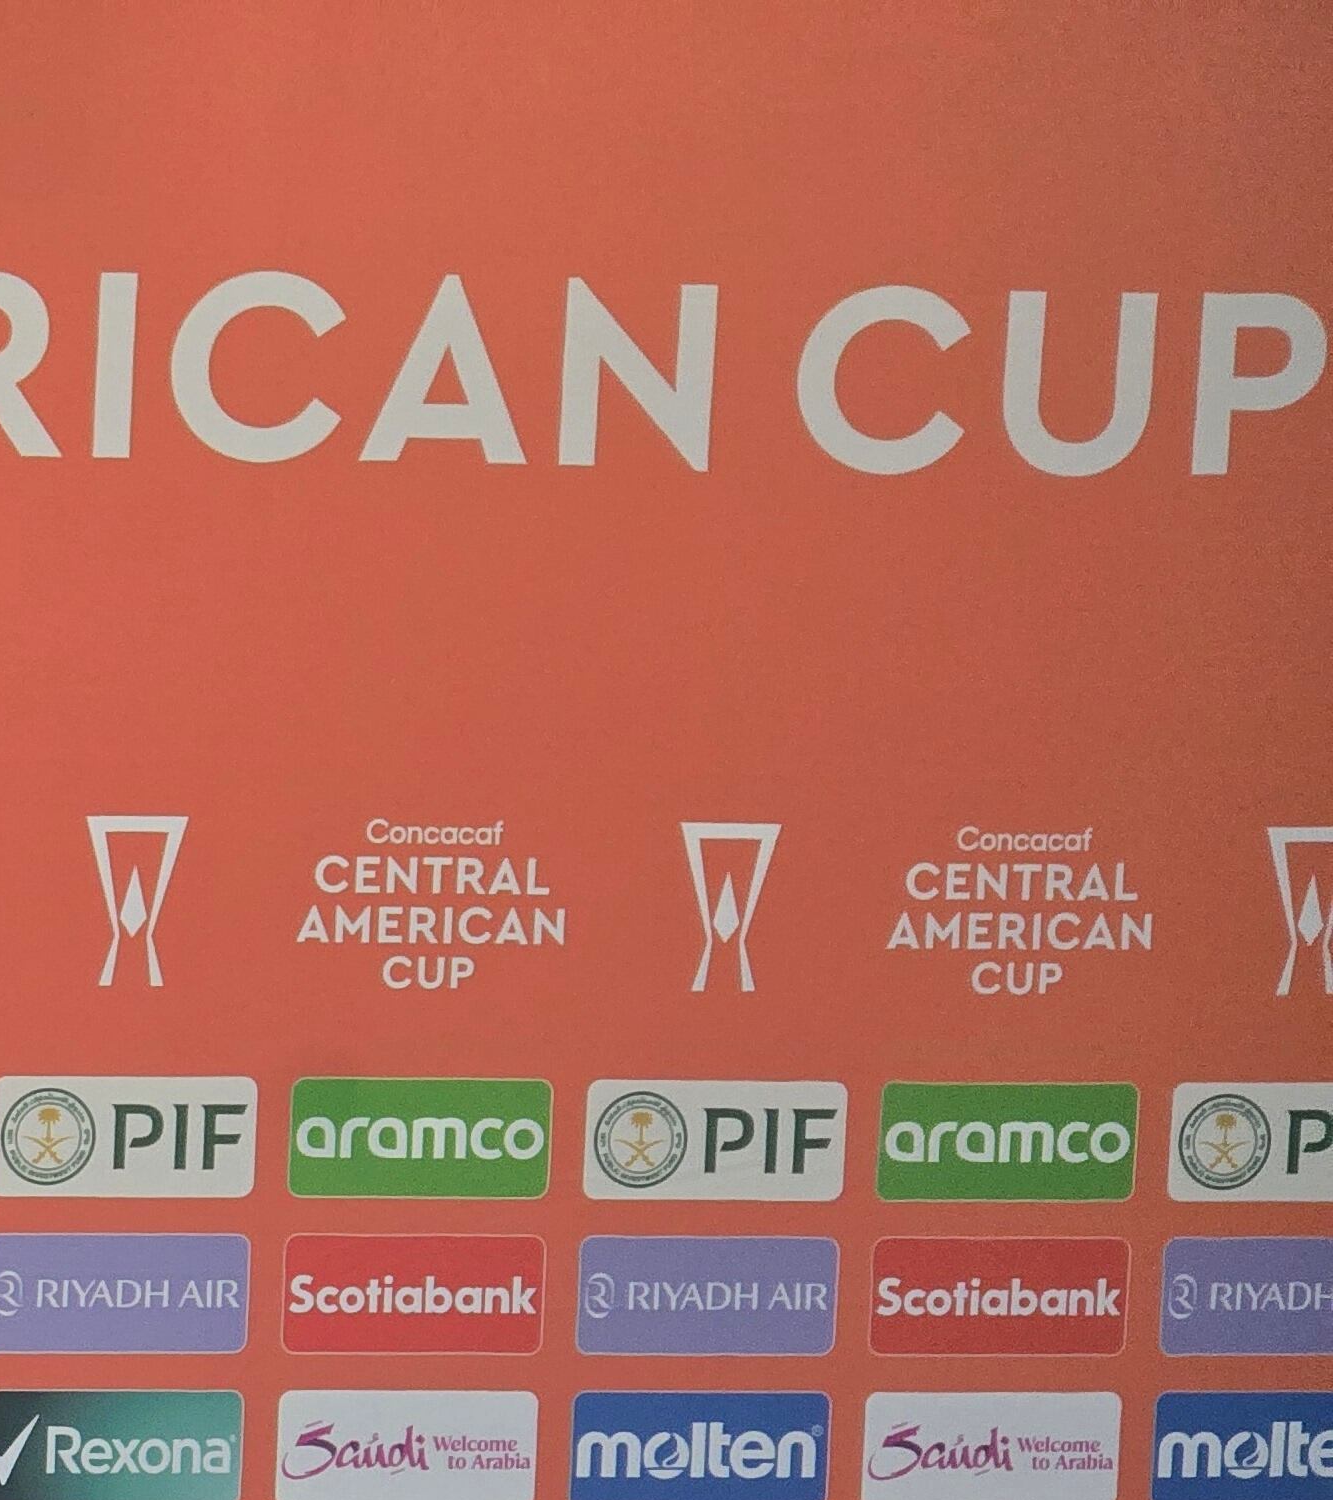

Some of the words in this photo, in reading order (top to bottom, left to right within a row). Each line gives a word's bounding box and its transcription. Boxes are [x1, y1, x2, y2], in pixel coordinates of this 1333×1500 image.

[797, 285, 1327, 476] CUP
[367, 819, 503, 845] Concacaf
[957, 826, 1092, 851] Concacaf
[315, 855, 549, 895] CENTRAL
[906, 862, 1137, 901] CENTRAL
[297, 905, 565, 945] AMERICAN
[887, 912, 1152, 950] AMERICAN
[383, 956, 474, 989] CUP
[972, 962, 1062, 995] CUP
[113, 1104, 248, 1170] PIF
[296, 1117, 544, 1159] aramco
[706, 1108, 837, 1174] PIF
[885, 1121, 1130, 1163] aramco
[37, 1280, 169, 1307] RIYADH
[179, 1280, 239, 1307] AIR
[289, 1275, 536, 1313] Scotiabank
[628, 1282, 758, 1310] RIYADH
[769, 1283, 826, 1310] AIR
[876, 1278, 1120, 1316] Scotiabank
[46, 1426, 231, 1474] Rexona
[433, 1436, 518, 1452] Welcome
[448, 1455, 466, 1470] to
[471, 1453, 531, 1470] Arabia
[576, 1422, 816, 1479] molten
